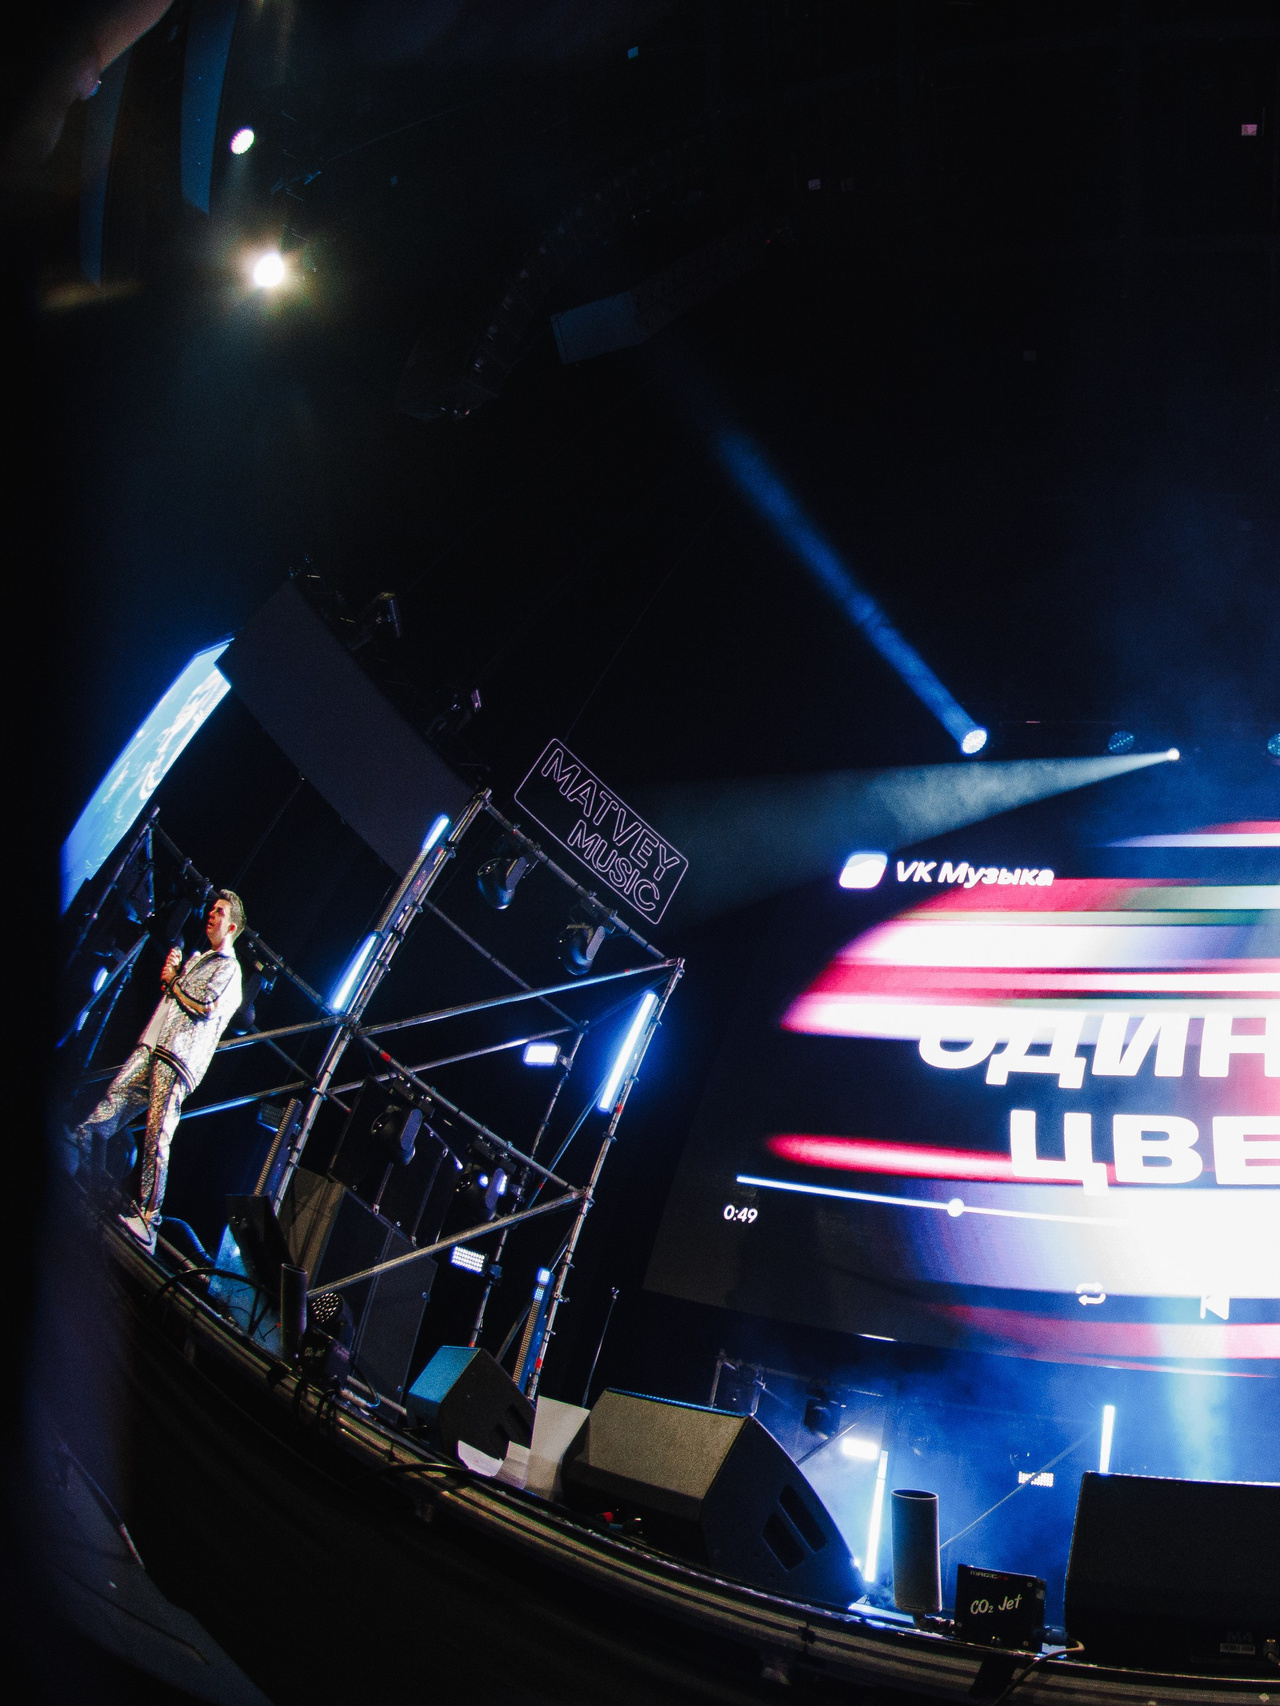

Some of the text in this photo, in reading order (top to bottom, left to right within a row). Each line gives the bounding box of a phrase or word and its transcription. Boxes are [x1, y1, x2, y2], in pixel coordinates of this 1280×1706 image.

[541, 748, 680, 881] MATVEY
[567, 819, 660, 911] MUSIC
[897, 861, 1055, 889] VK Музыка
[723, 1204, 758, 1224] 0:49
[998, 1593, 1023, 1611] Jet
